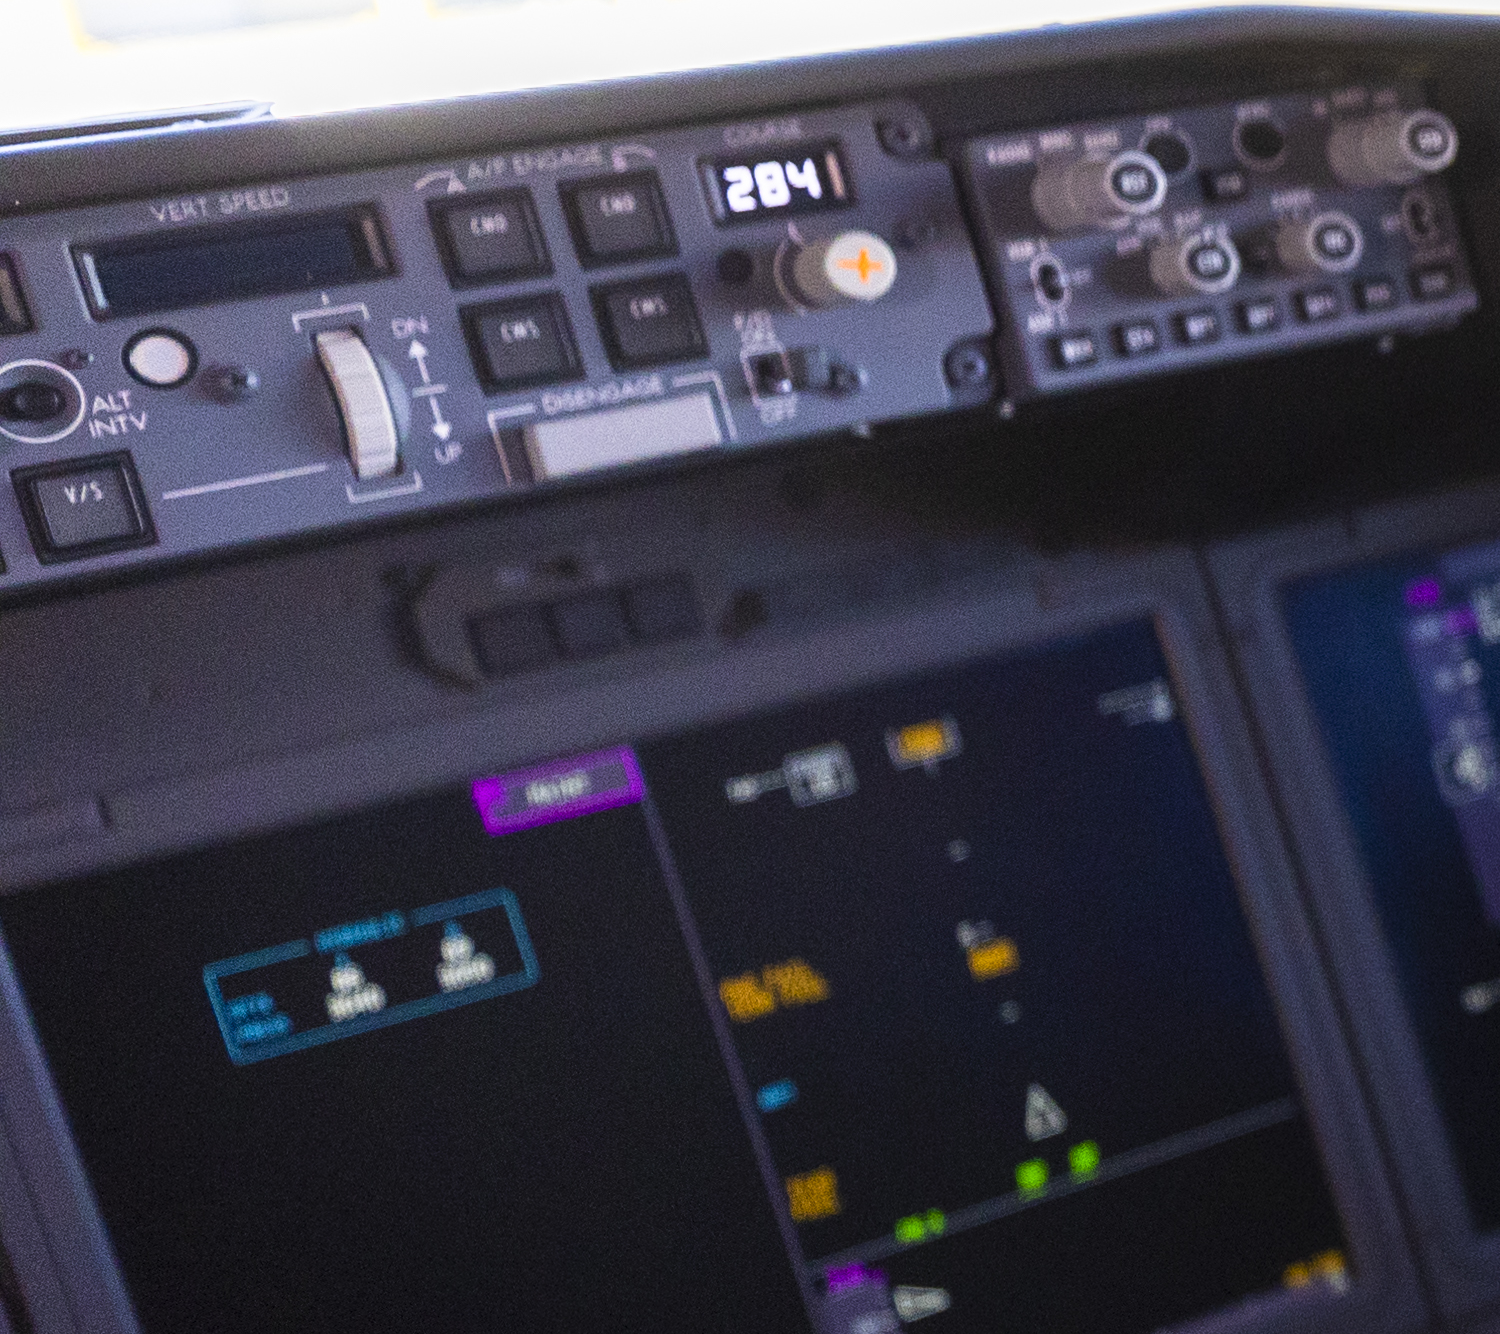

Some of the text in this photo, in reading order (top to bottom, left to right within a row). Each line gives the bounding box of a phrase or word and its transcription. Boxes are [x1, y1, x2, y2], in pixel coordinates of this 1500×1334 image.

[722, 157, 823, 213] 284
[149, 186, 290, 223] VERT SPEED
[92, 389, 132, 415] ALT
[88, 412, 148, 439] INTV
[62, 485, 104, 505] V/S
